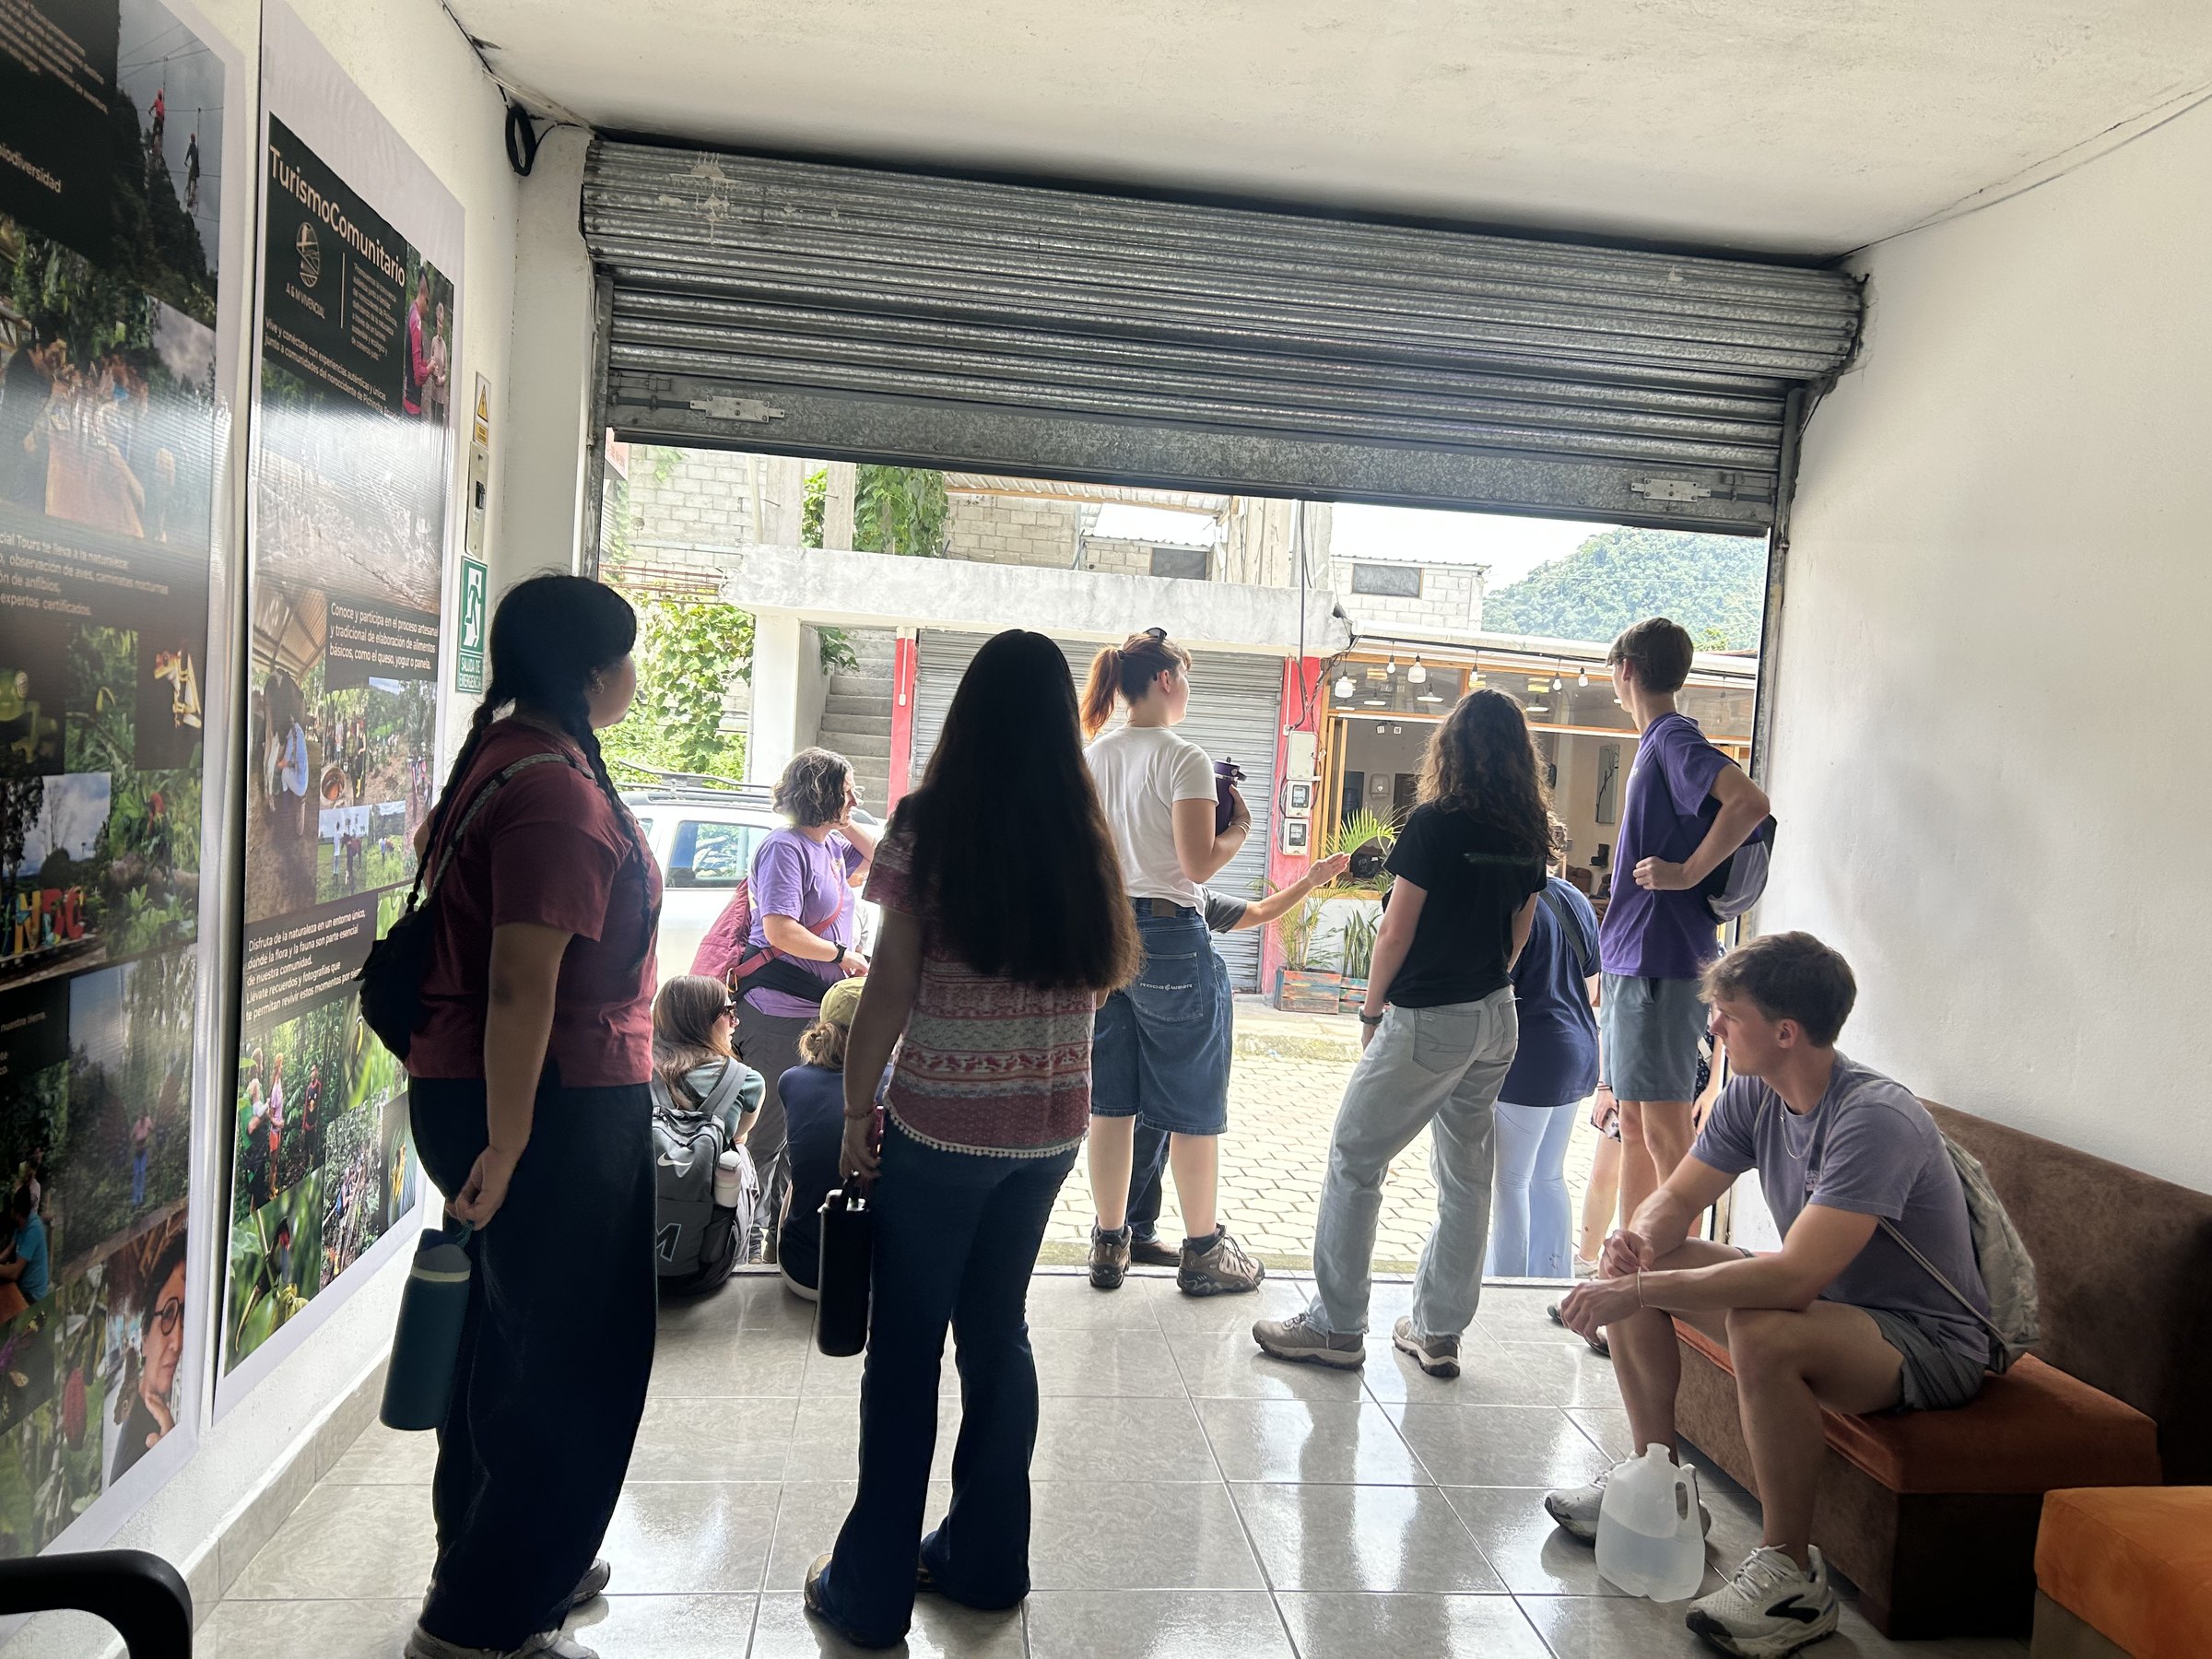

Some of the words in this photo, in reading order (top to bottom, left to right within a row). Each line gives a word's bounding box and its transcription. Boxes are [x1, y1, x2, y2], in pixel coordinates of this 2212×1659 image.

[265, 316, 277, 334] Vive
[277, 326, 282, 338] y
[309, 347, 318, 359] con
[319, 368, 327, 380] del
[17, 535, 41, 551] Tours
[9, 553, 62, 573] observación
[11, 572, 23, 586] de
[0, 593, 39, 608] expertos
[331, 602, 355, 619] Conoce
[355, 610, 359, 623] y
[359, 610, 383, 628] participa
[385, 617, 392, 627] en
[393, 617, 397, 628] el
[398, 619, 417, 633] proceso
[418, 624, 438, 637] artesanal
[330, 627, 334, 639] y
[335, 625, 366, 641] tradicional
[368, 629, 375, 643] de
[376, 631, 406, 648] elaboración
[406, 636, 412, 650] de
[413, 638, 436, 653] alimentos
[330, 642, 353, 661] básicos,
[355, 650, 371, 661] como
[371, 650, 377, 662] el
[378, 653, 395, 665] queso,
[394, 655, 409, 668] yogur
[410, 658, 414, 667] o
[414, 658, 430, 670] panela.
[248, 936, 273, 952] Disfruta
[274, 933, 281, 945] de
[282, 930, 288, 941] la
[288, 924, 316, 939] naturaleza
[318, 921, 324, 931] en
[325, 919, 333, 927] un
[334, 913, 351, 926] entorno
[248, 952, 267, 970] donde
[268, 950, 274, 962] la
[275, 947, 288, 959] flora
[288, 947, 293, 959] y
[294, 944, 299, 955] la
[299, 940, 315, 952] fauna
[316, 938, 325, 947] son
[325, 933, 339, 946] parte
[340, 924, 359, 940] esencial
[246, 985, 268, 1004] Llévate
[269, 977, 298, 996] recuerdos
[298, 976, 302, 986] y
[302, 963, 331, 982] fotografías
[331, 961, 341, 974] que
[247, 974, 255, 987] de
[256, 967, 279, 983] nuestra
[280, 955, 312, 975] comunidad.
[245, 1008, 253, 1021] te
[253, 998, 281, 1021] permitan
[282, 991, 299, 1006] revivir
[300, 986, 314, 999] estos
[315, 977, 341, 994] momentos
[350, 967, 363, 980] siem
